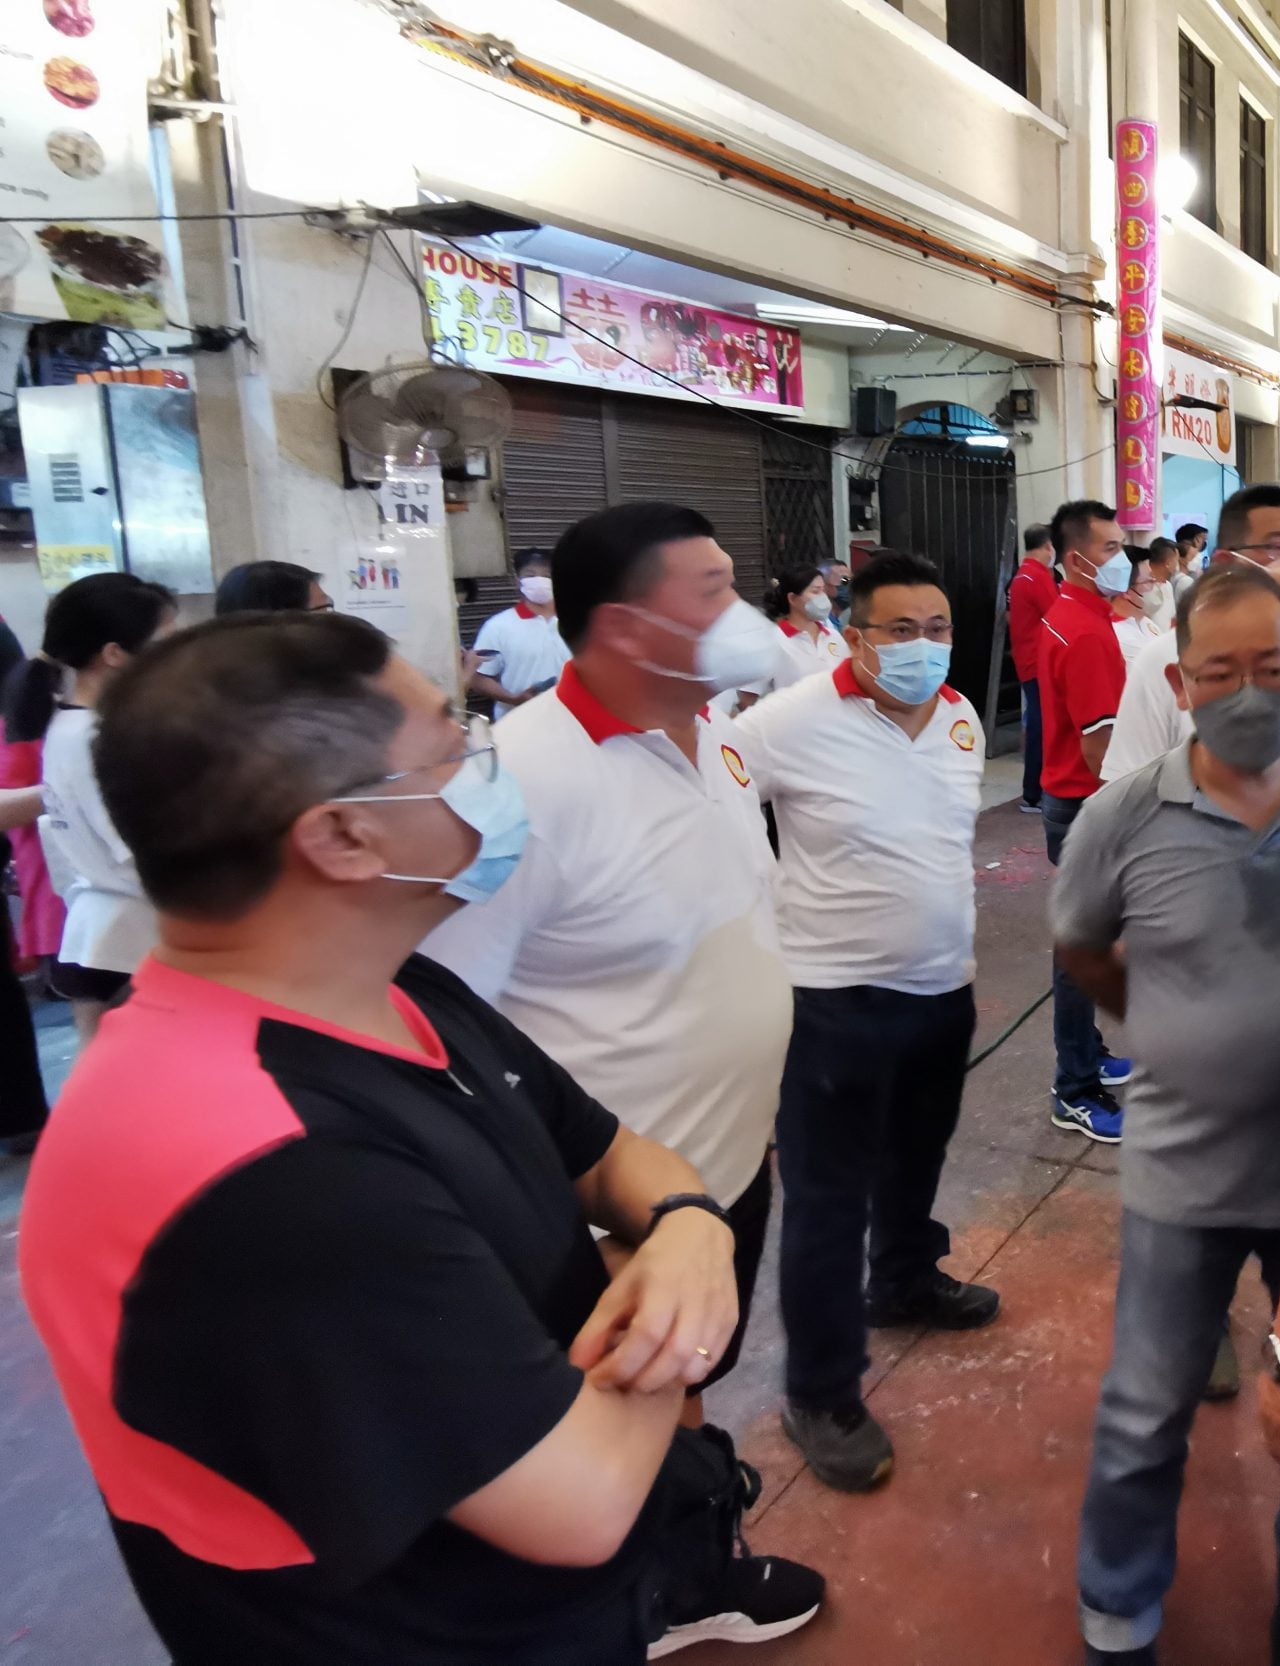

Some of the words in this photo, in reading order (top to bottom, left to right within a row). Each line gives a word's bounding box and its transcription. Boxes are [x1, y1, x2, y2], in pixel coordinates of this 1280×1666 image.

[422, 246, 513, 289] HOUSE
[1171, 408, 1212, 446] RM20
[395, 503, 430, 524] IN
